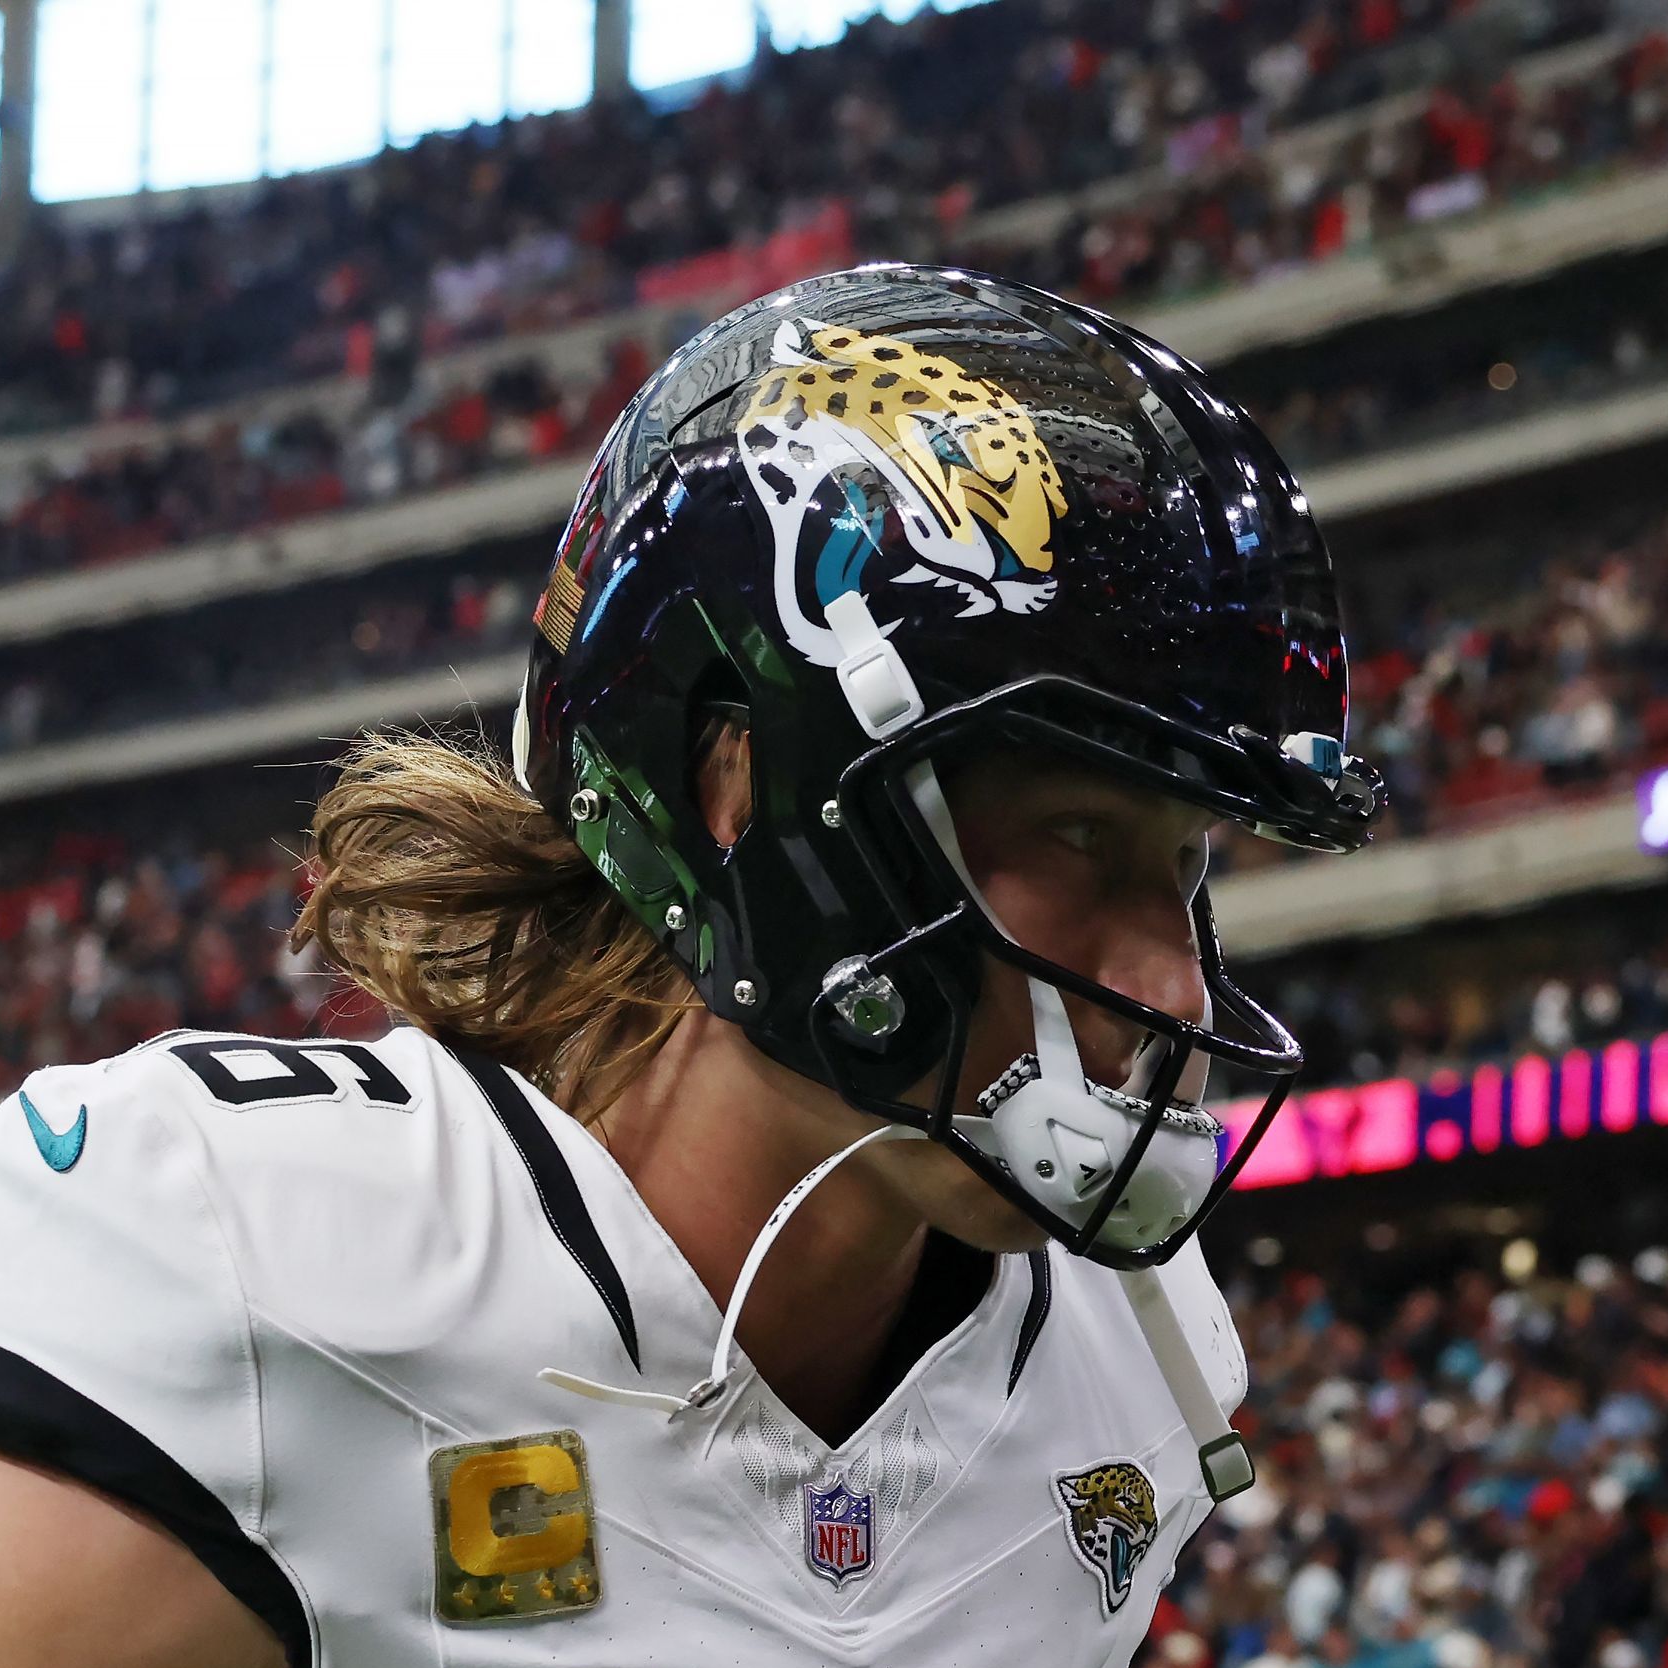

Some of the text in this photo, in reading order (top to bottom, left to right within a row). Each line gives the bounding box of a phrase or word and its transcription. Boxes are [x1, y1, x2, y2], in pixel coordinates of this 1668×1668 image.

[138, 1031, 413, 1106] 6
[448, 1444, 587, 1577] C
[816, 1523, 865, 1569] NFL
